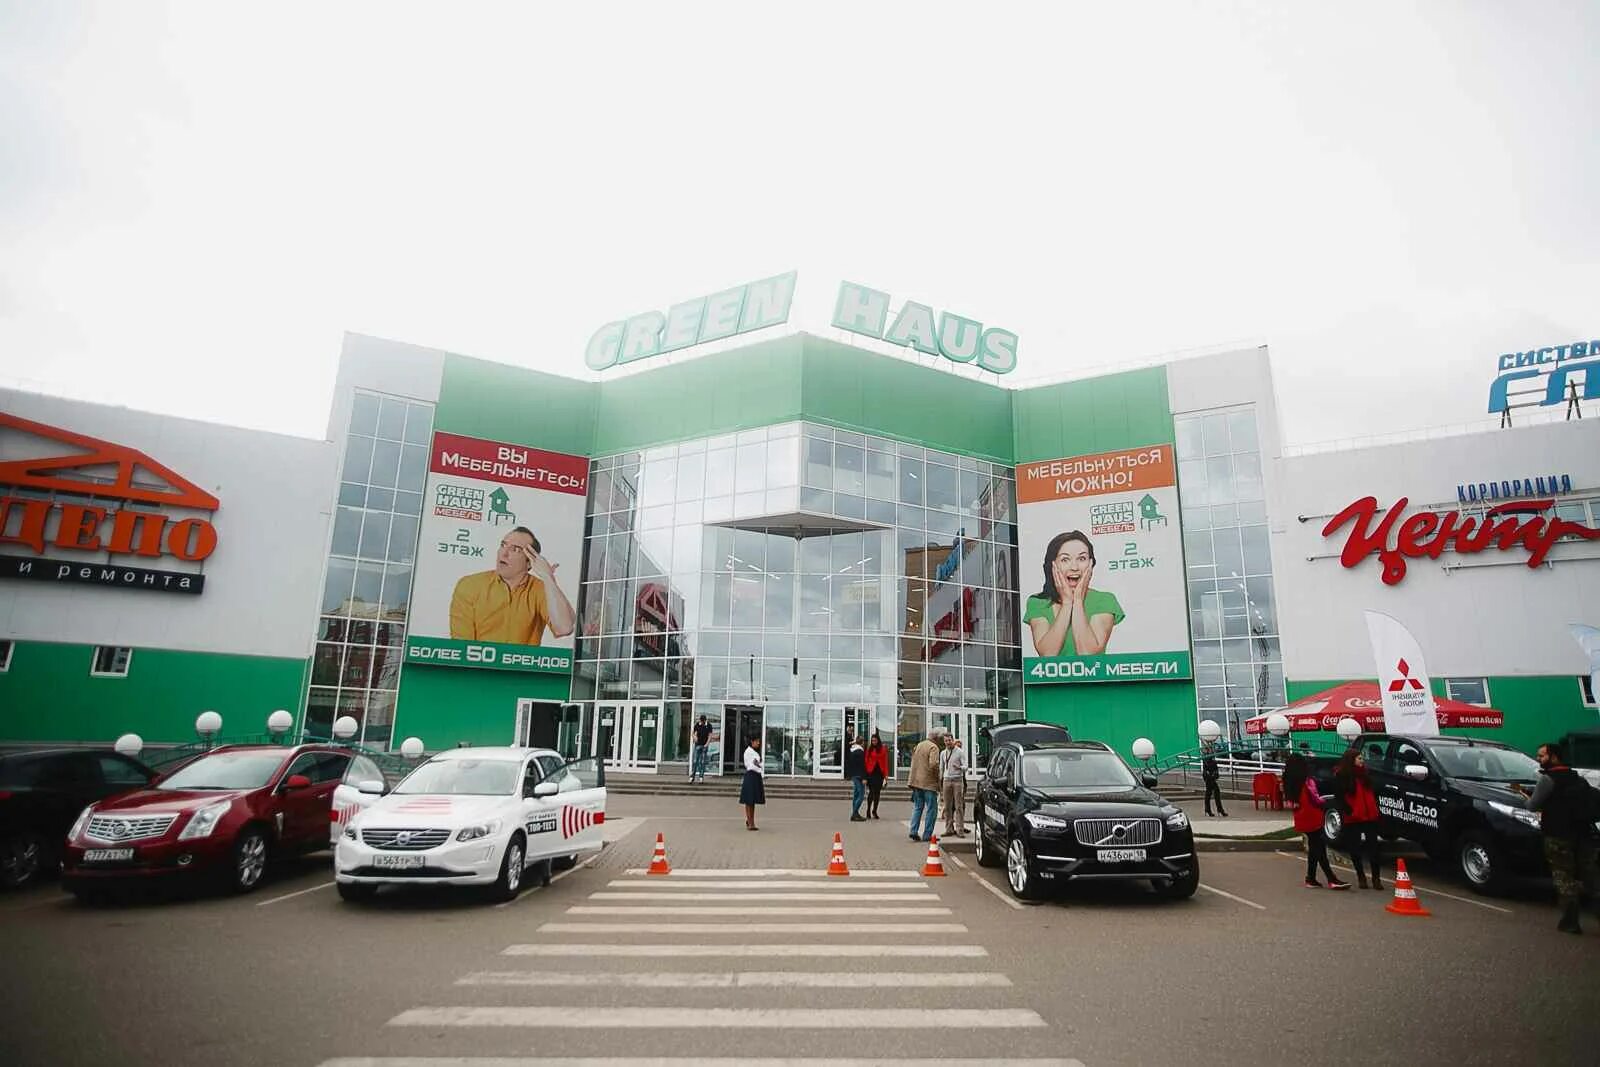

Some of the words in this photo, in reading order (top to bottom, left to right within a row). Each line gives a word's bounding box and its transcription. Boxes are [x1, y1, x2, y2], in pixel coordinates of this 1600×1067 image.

[585, 270, 798, 371] GREEN
[831, 280, 1019, 374] HAUS
[498, 447, 528, 464] ВЫ
[1027, 449, 1162, 480] МЕБЕЛЬНУТЬСЯ
[1055, 471, 1134, 494] МОЖНО!
[1457, 474, 1572, 501] КОРПОРАЦИЯ
[436, 484, 484, 499] GREEN
[436, 494, 484, 511] HAUS
[1090, 501, 1134, 515] GREEN
[435, 507, 482, 521] МЕБЕЛЬ
[1091, 511, 1134, 525] HAUS
[0, 494, 218, 561] ДЕПО
[456, 529, 470, 542] 2
[1092, 523, 1135, 535] МЕБЕЛЬ
[1124, 542, 1138, 555] 2
[1322, 496, 1600, 585] Центр
[19, 562, 32, 573] и
[58, 563, 191, 589] ремонта
[409, 646, 462, 660] БОЛЕЕ
[466, 645, 496, 662] 50
[502, 653, 569, 668] БРЕНДОВ
[1106, 661, 1178, 676] МЕБЕЛИ
[1378, 795, 1405, 811] НОВЫЙ
[1409, 801, 1438, 819] L200
